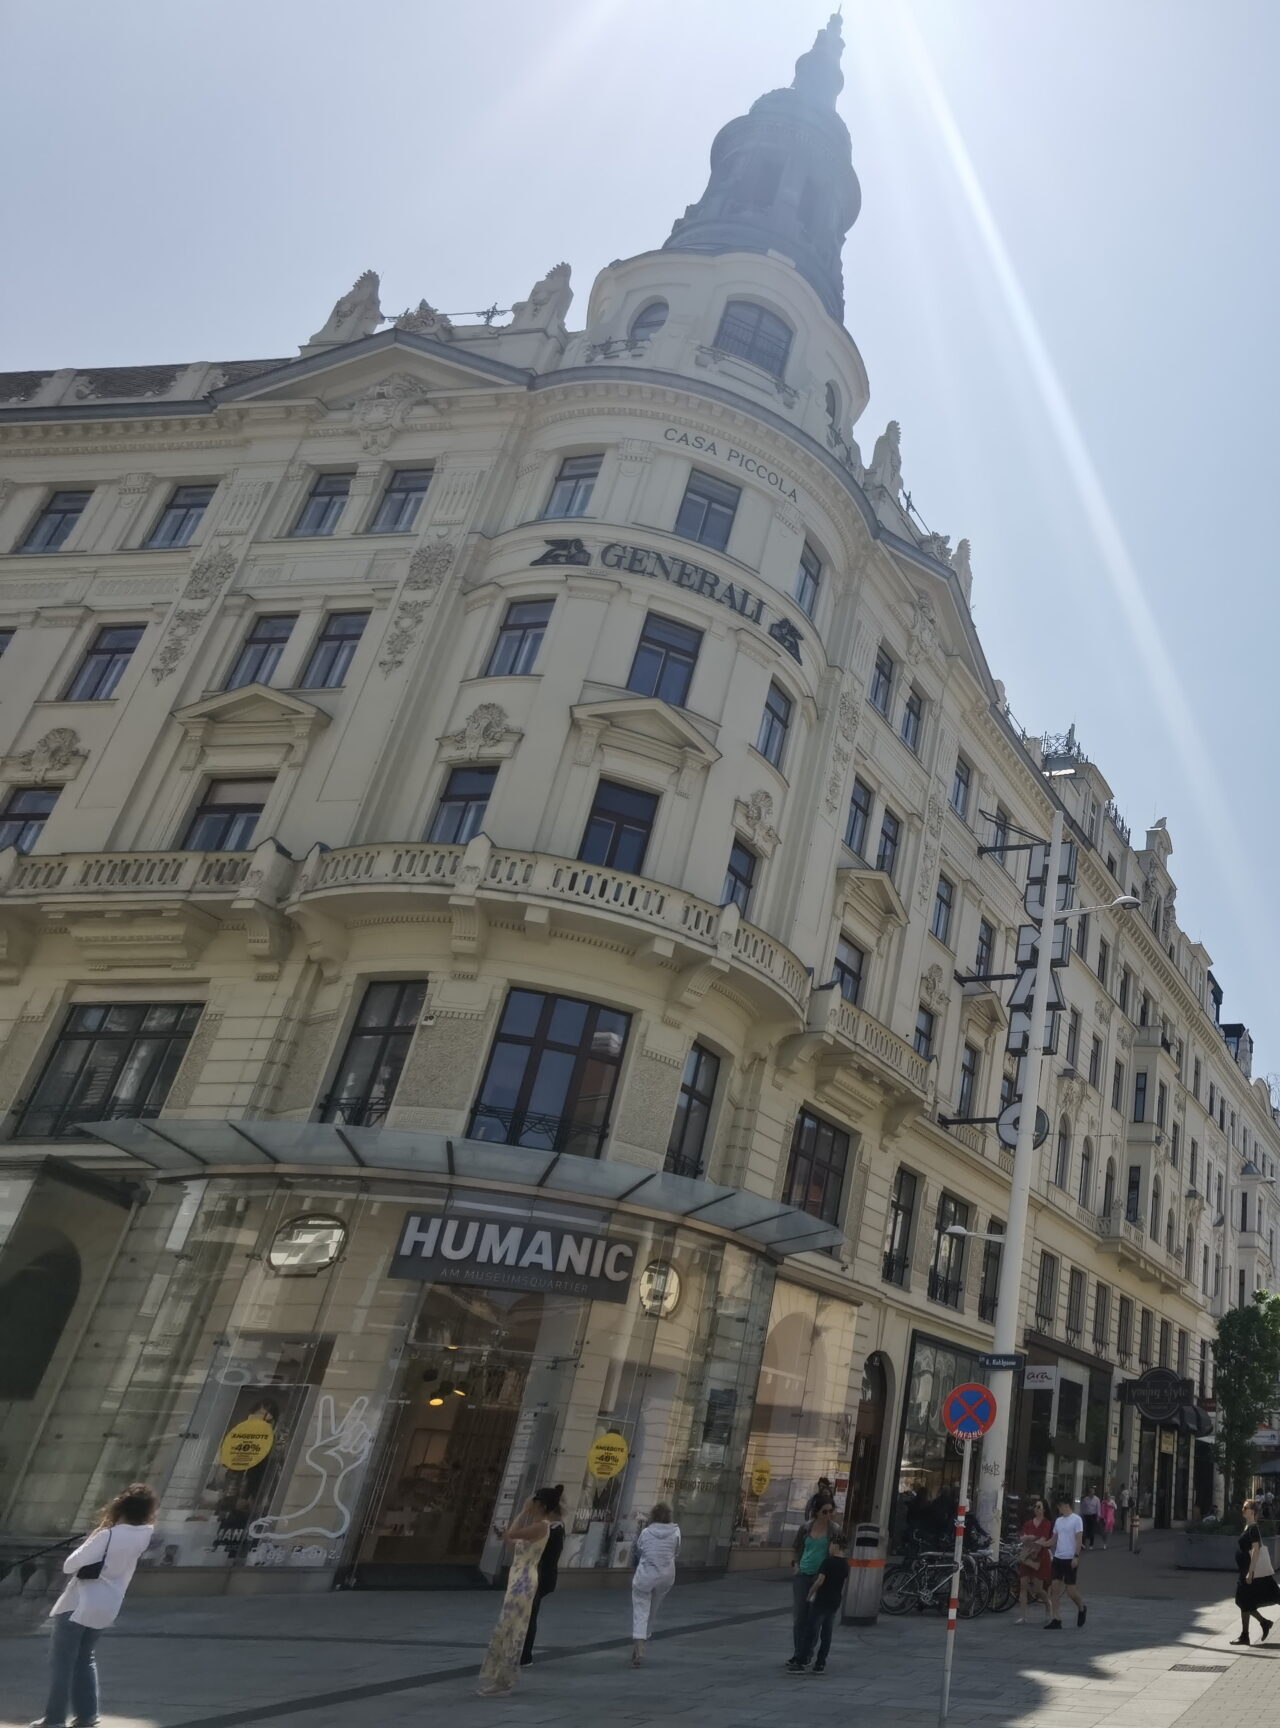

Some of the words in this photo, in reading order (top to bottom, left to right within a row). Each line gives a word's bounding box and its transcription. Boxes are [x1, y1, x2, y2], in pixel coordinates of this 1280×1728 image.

[663, 427, 718, 456] CASA
[727, 448, 799, 504] PICCOLA
[600, 542, 767, 627] GENERALI
[399, 1215, 634, 1282] HUMANIC
[439, 1268, 461, 1281] AM
[464, 1270, 590, 1294] MUSEUMSQUARTIER
[1027, 1370, 1053, 1381] ara
[231, 1432, 269, 1440] ANGEBOTE
[953, 1428, 984, 1439] ANFANG
